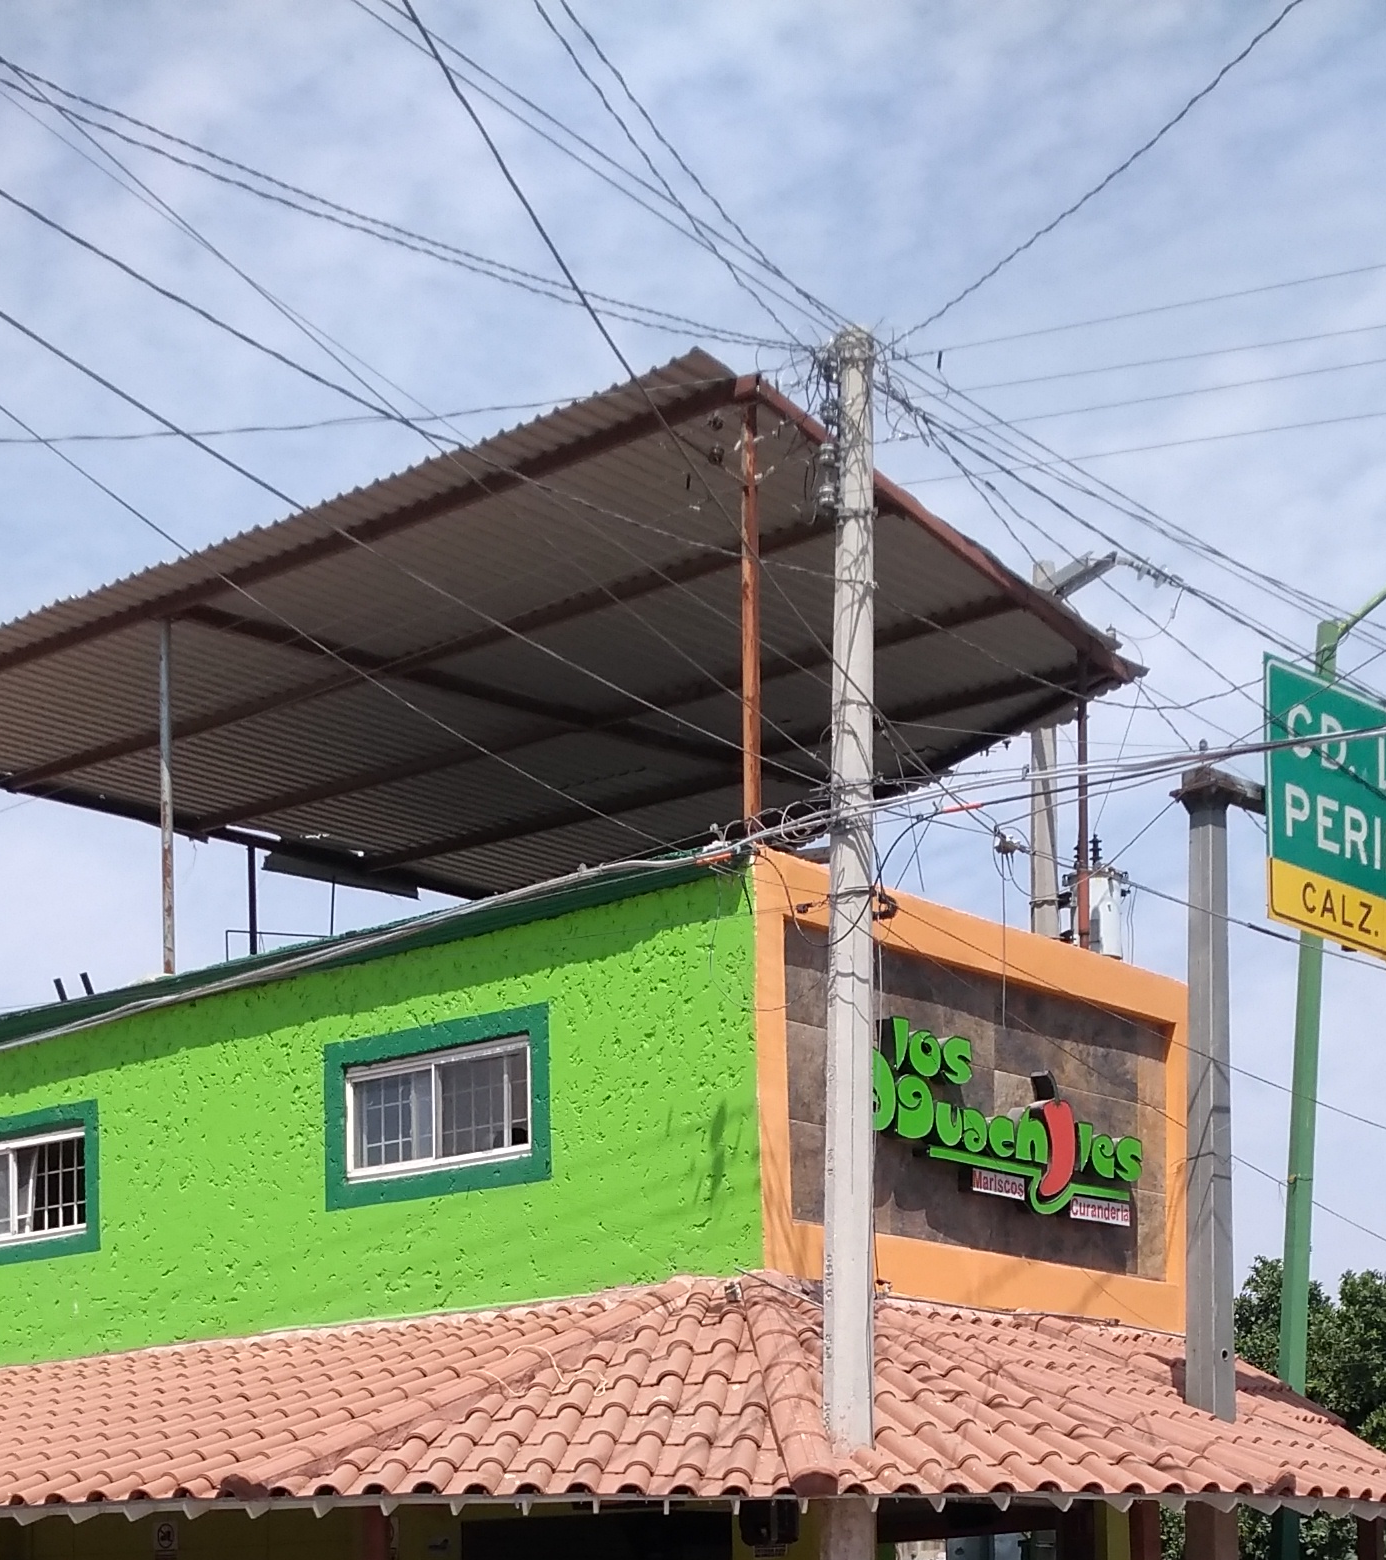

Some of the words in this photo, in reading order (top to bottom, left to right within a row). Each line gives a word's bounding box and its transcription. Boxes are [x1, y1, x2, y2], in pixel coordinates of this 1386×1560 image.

[1287, 703, 1356, 774] CD.
[1302, 882, 1379, 937] CALZ.
[973, 1169, 1024, 1198] Mariscos
